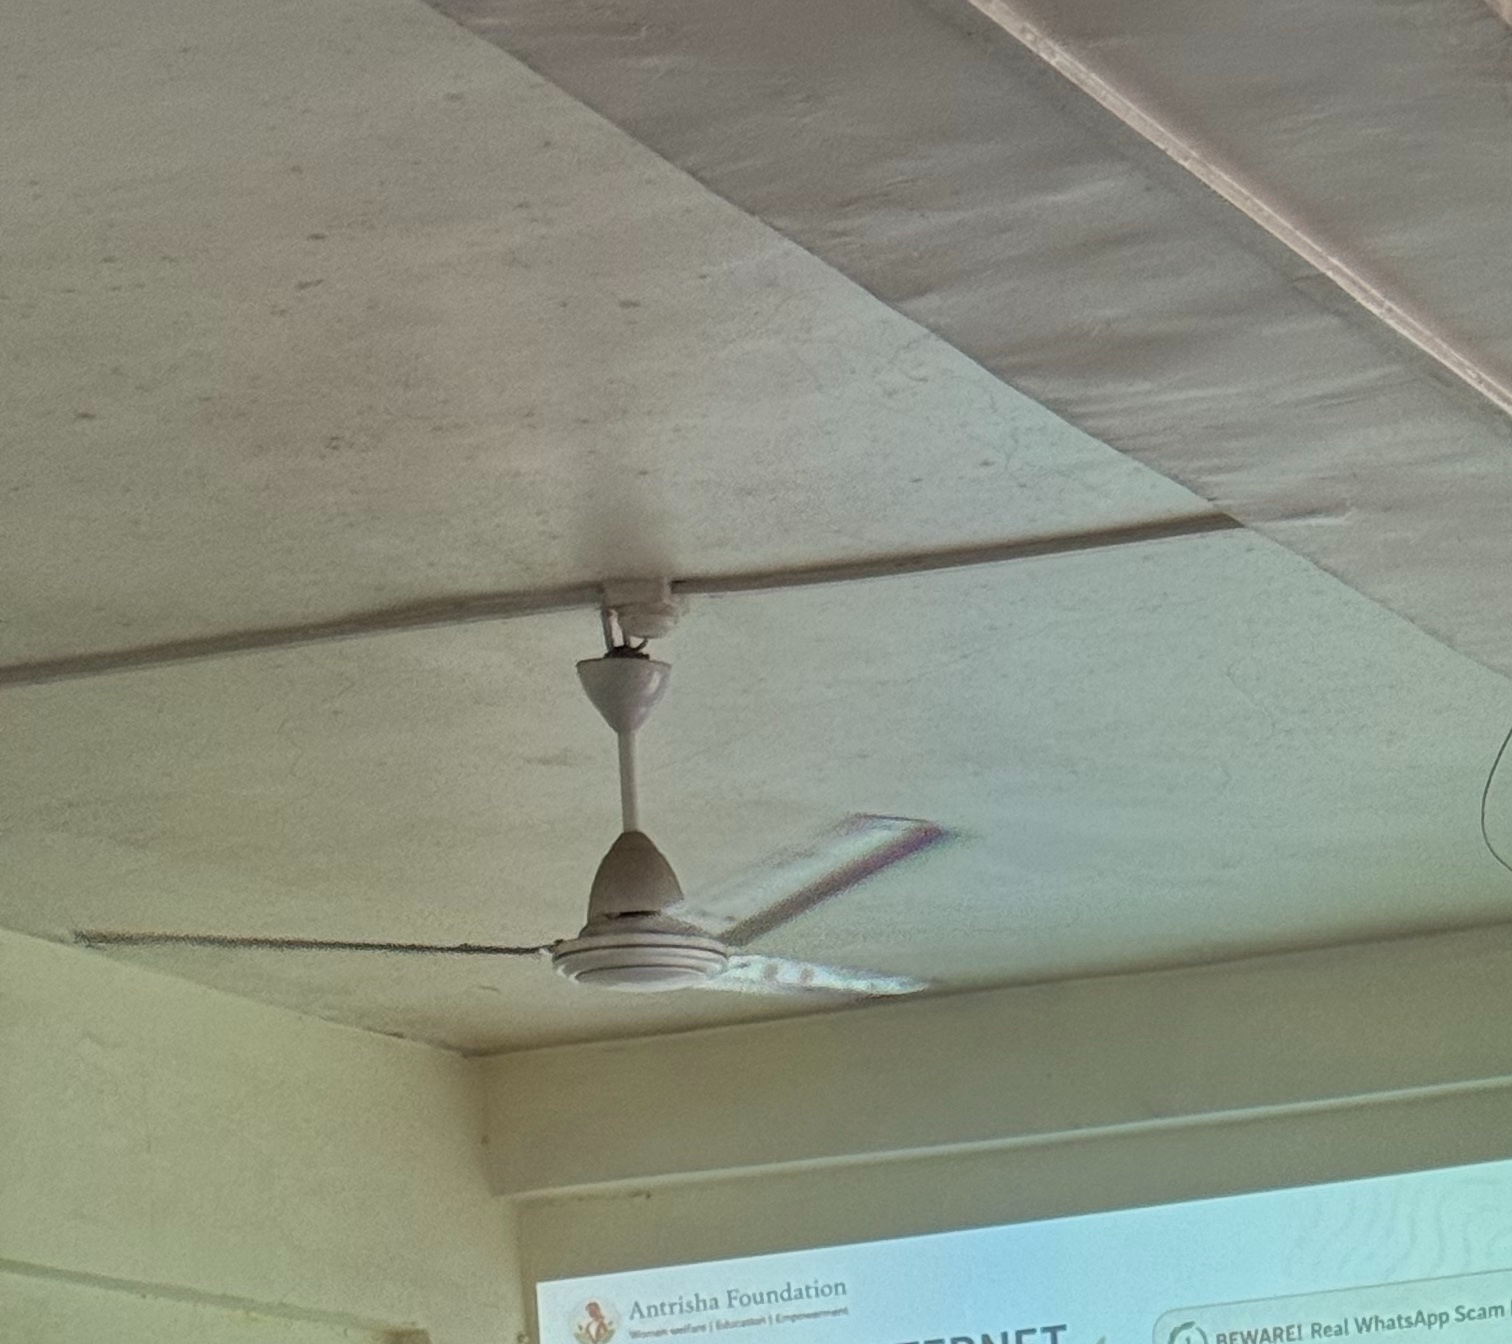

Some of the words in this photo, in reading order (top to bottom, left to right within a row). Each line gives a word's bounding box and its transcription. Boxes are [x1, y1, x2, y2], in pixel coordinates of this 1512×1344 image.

[629, 1293, 720, 1320] Antrisha
[726, 1279, 848, 1310] Foundation
[1310, 1318, 1349, 1339] Real
[1353, 1309, 1450, 1334] WhatsApp
[1454, 1301, 1505, 1322] Scam
